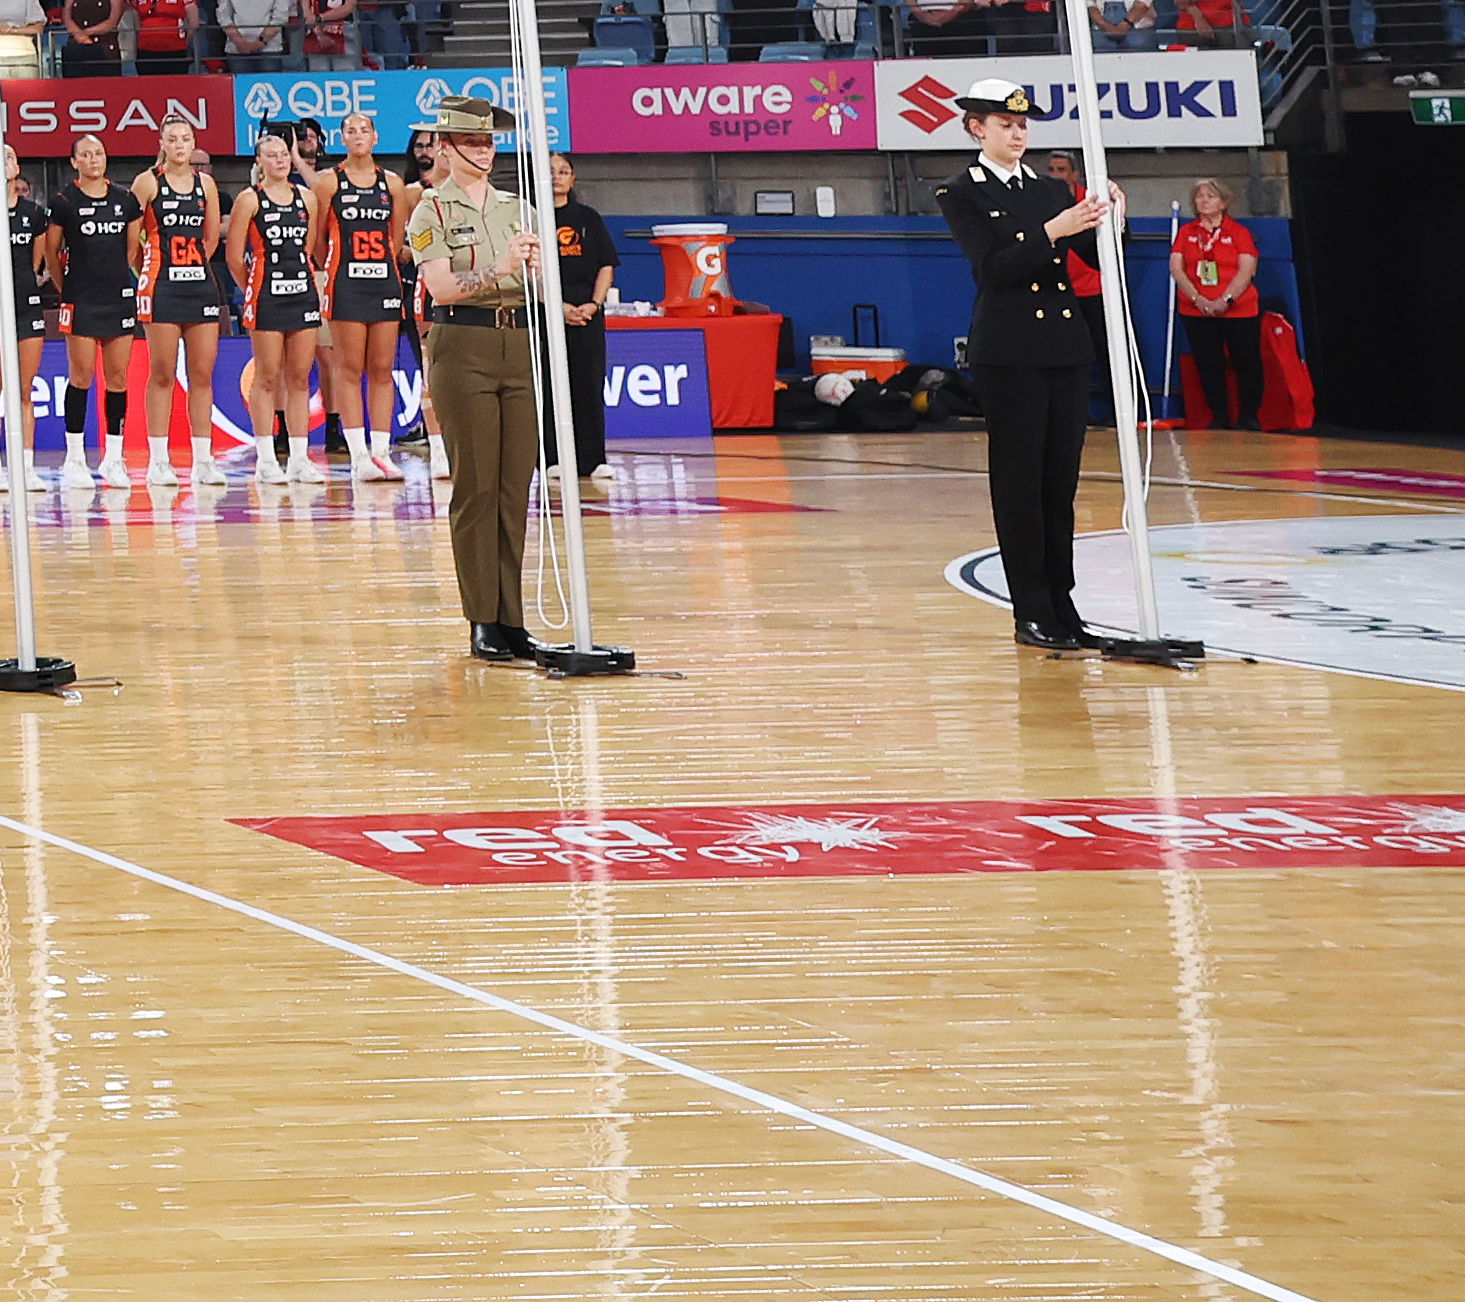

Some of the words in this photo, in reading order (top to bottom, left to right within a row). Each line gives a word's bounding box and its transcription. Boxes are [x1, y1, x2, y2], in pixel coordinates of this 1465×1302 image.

[287, 79, 378, 119] QBE
[632, 80, 793, 118] aware
[1020, 79, 1239, 122] UZUKI
[708, 117, 794, 142] super
[96, 221, 126, 234] HCF
[359, 208, 391, 221] HCF
[282, 226, 308, 239] HCF
[352, 229, 386, 261] GS
[169, 235, 204, 267] GA
[696, 245, 723, 276] G
[361, 819, 676, 853] red
[1015, 807, 1343, 839] red
[490, 842, 803, 868] energy
